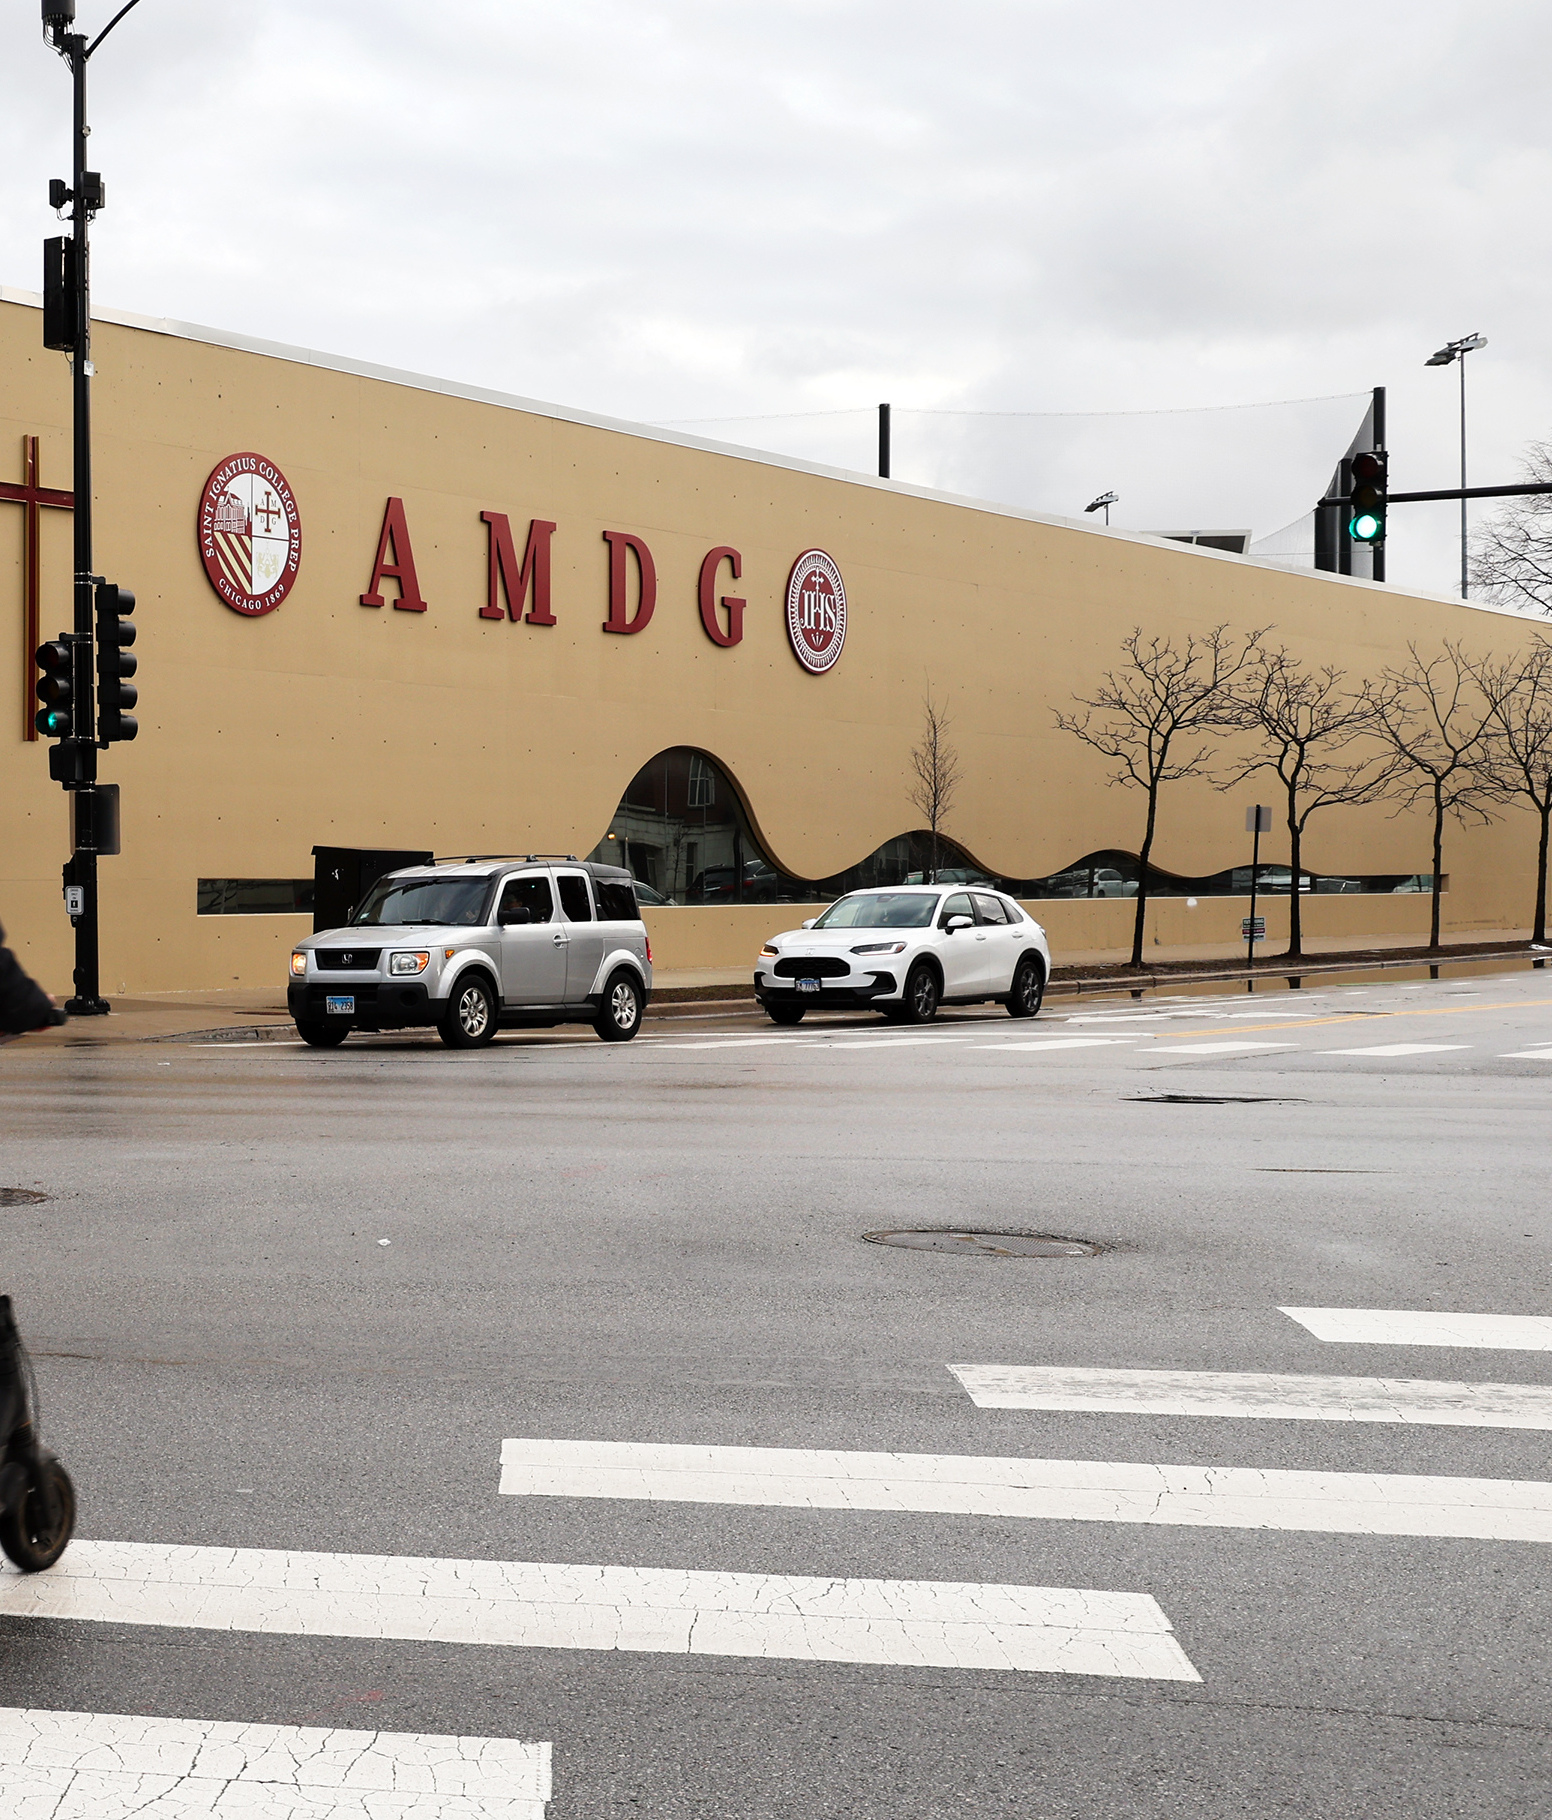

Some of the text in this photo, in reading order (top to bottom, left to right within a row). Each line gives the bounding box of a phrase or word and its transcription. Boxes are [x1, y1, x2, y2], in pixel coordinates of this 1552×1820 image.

[203, 457, 300, 572] SAINT IGNATIUS COLLEGE PREP
[218, 578, 285, 610] CHICAGO 1869
